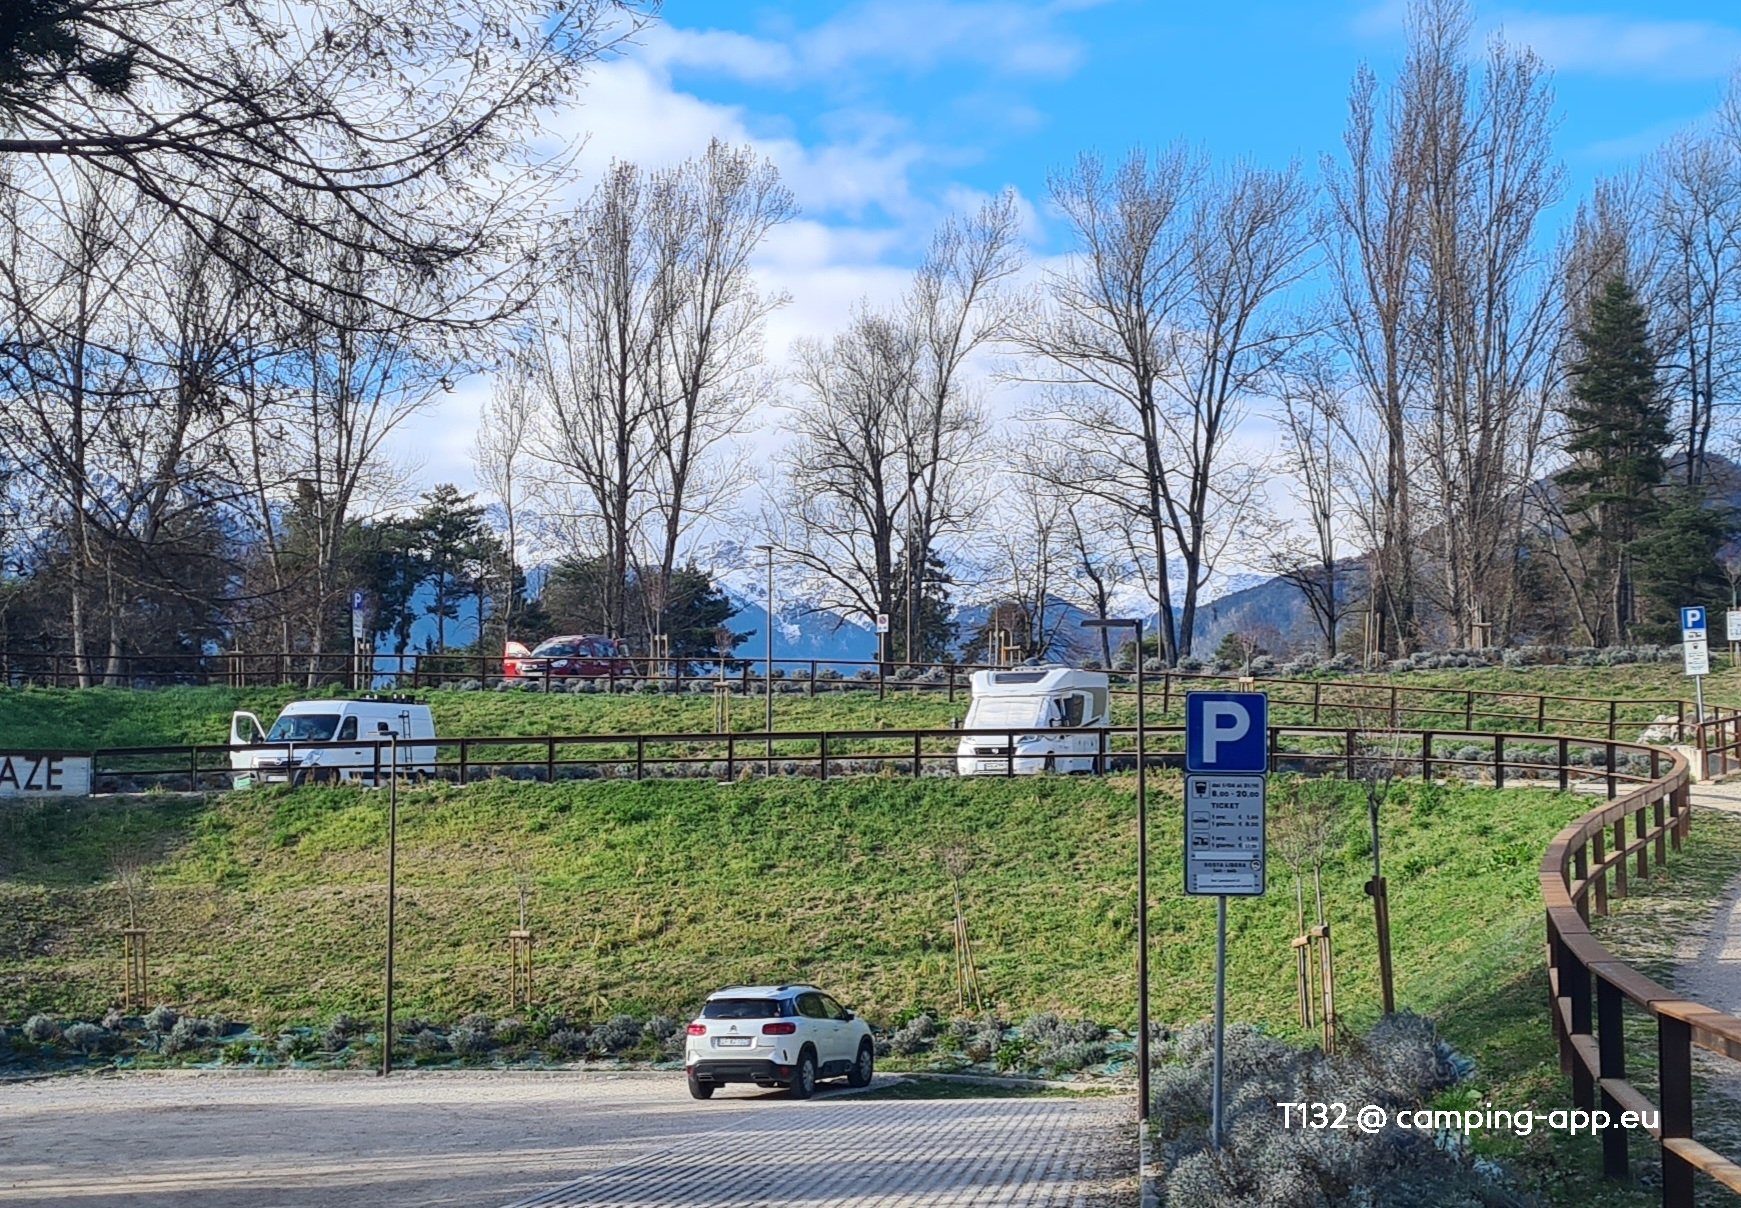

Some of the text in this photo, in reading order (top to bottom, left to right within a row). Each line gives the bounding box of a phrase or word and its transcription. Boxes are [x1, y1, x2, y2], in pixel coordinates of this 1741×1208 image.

[354, 593, 361, 608] P
[1686, 610, 1701, 627] P
[1203, 701, 1250, 763] P
